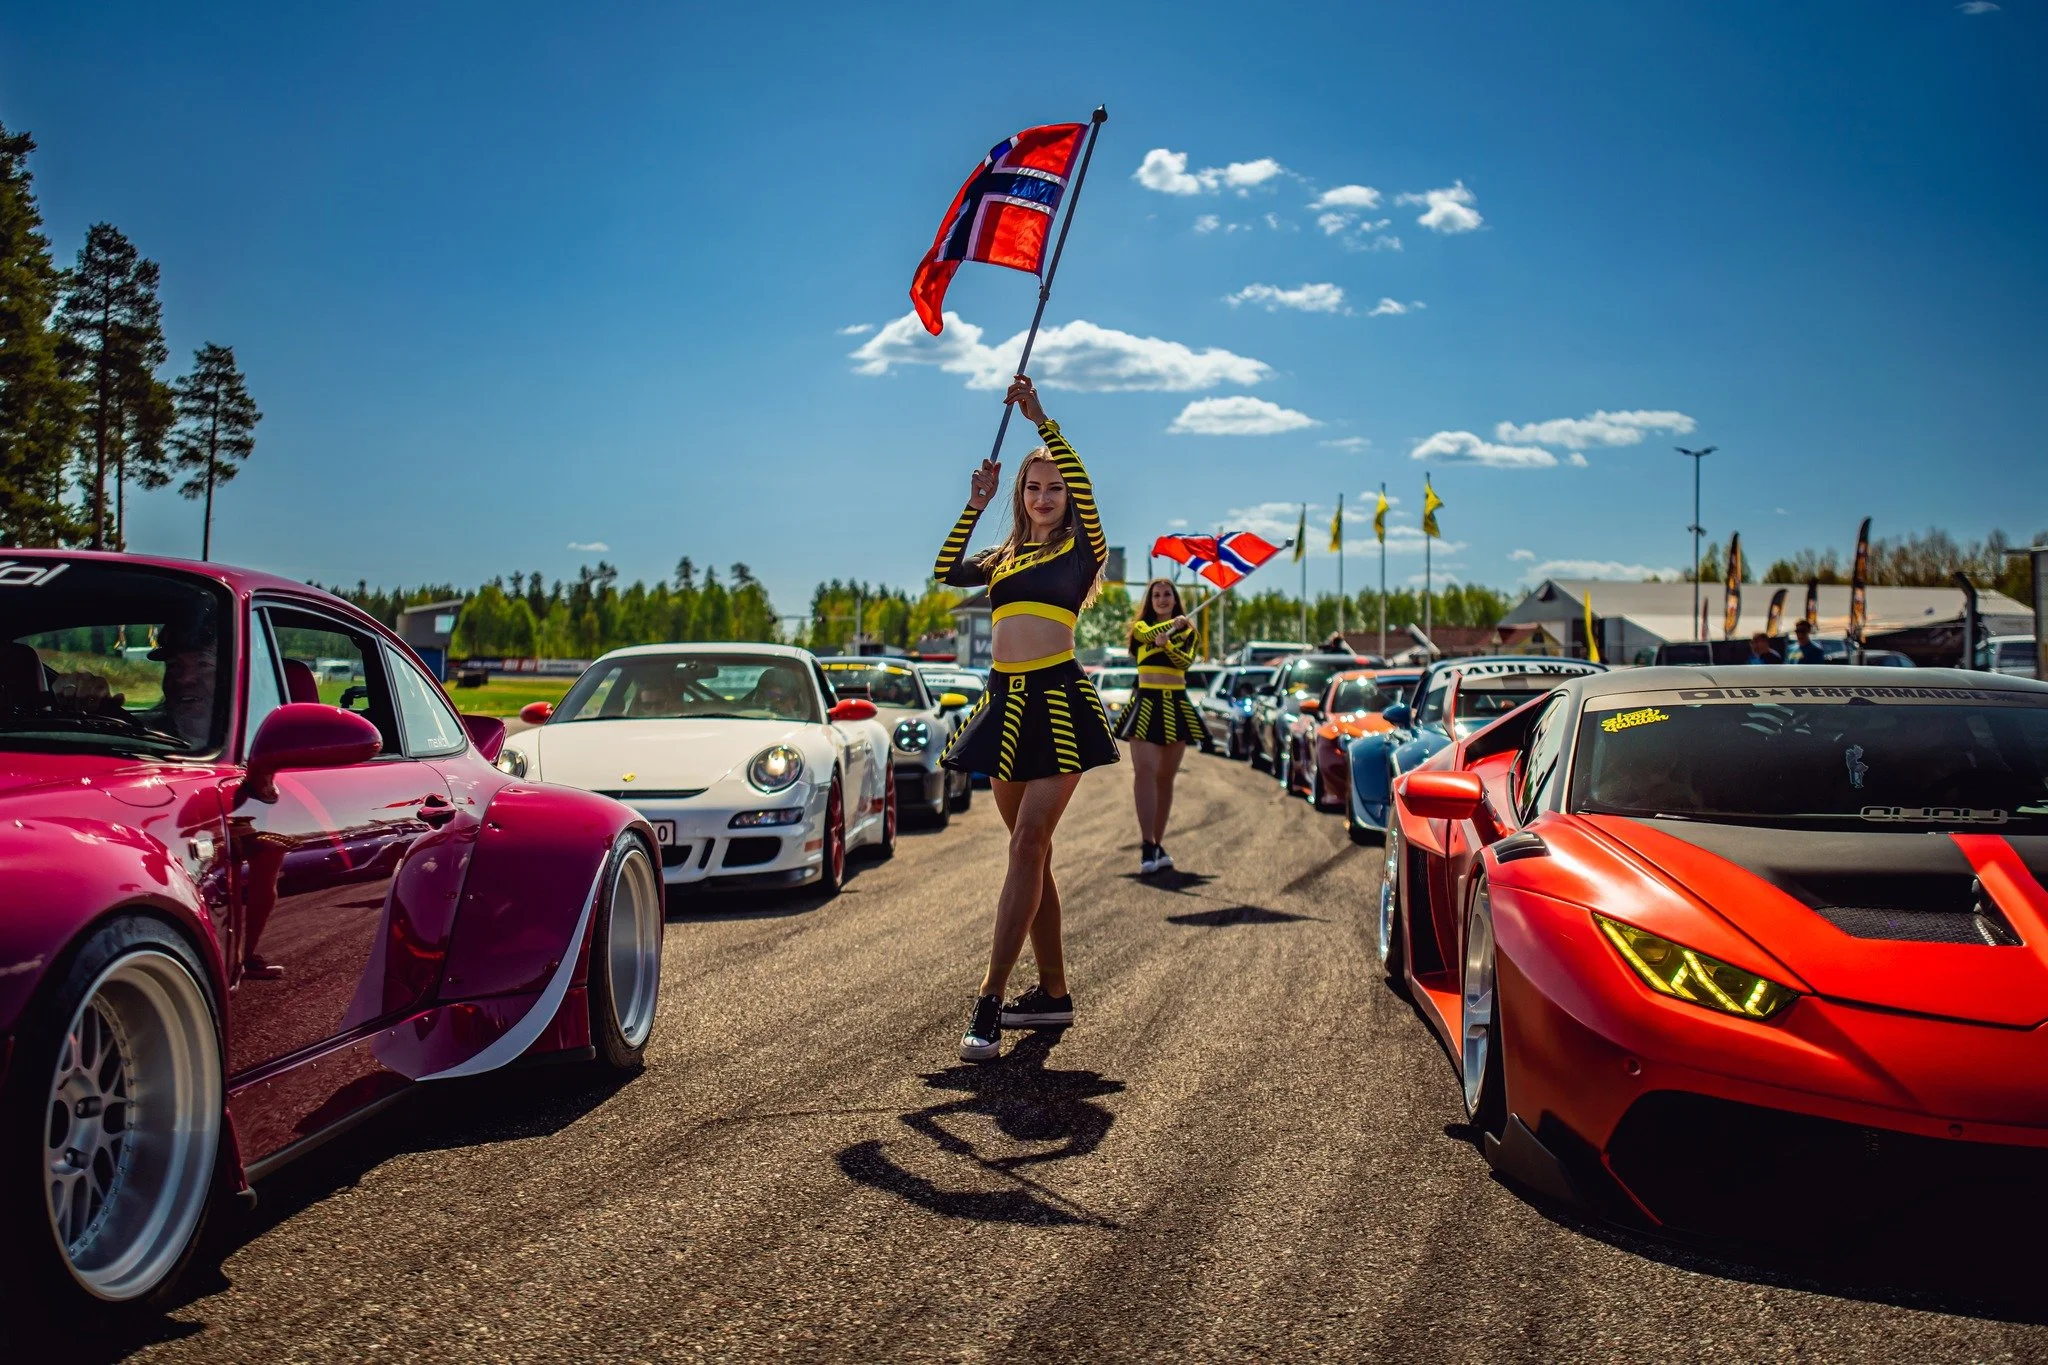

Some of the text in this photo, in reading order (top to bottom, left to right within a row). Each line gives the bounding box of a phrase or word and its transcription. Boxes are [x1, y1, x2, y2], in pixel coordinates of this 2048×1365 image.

[1012, 678, 1022, 690] G
[1726, 687, 1986, 700] LB PERFORMANCE
